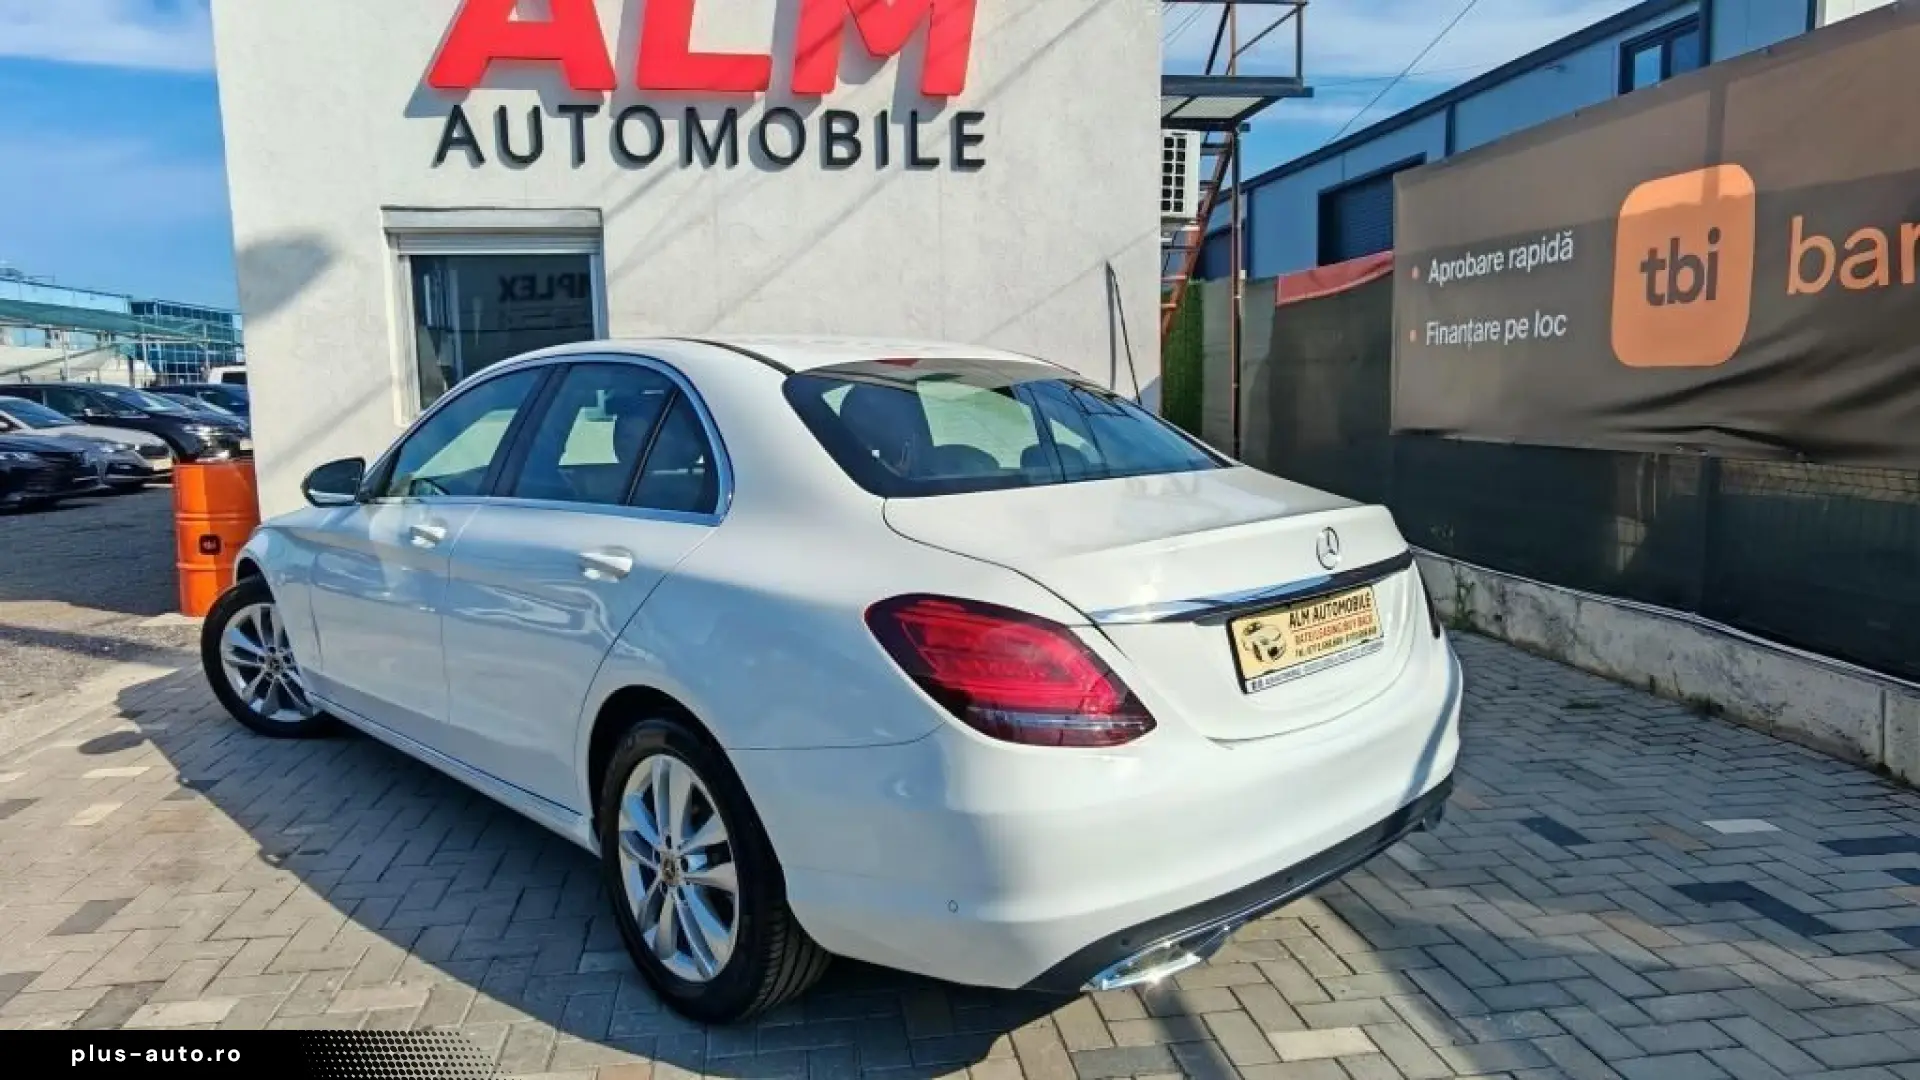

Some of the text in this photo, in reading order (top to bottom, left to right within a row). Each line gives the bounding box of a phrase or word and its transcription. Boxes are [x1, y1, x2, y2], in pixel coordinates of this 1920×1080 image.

[428, 0, 975, 96] ALM
[434, 104, 986, 169] AUTOMOBILE
[1428, 230, 1574, 287] Aprobare rapidă
[1639, 226, 1722, 307] tbi
[1426, 310, 1567, 350] Finanțare pe loc
[1289, 591, 1371, 628] ALM AUTOMOBILE
